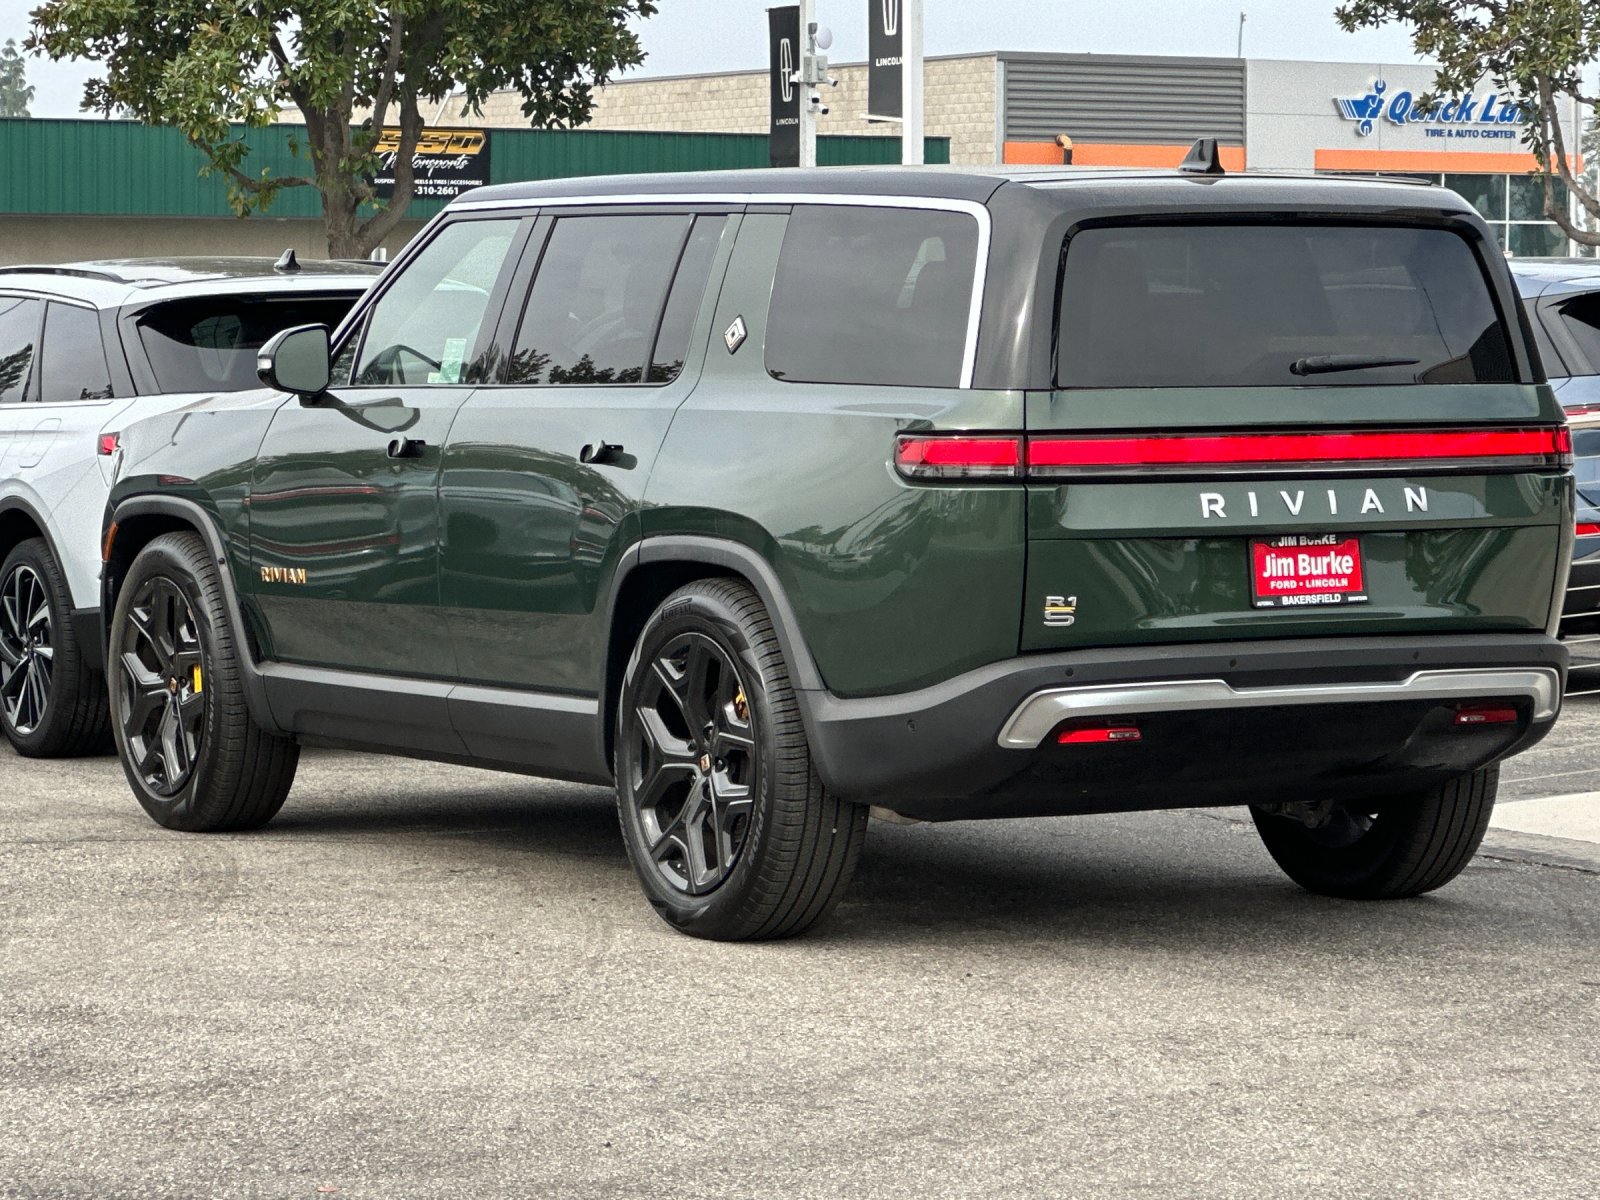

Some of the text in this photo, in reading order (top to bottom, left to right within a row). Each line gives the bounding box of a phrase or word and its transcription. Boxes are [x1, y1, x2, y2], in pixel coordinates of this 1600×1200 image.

[876, 57, 903, 66] LINCOLN
[775, 118, 799, 126] LINCOLN
[1425, 129, 1516, 139] TIRE & AUTO CENTER
[378, 150, 473, 178] Mtorsports
[1199, 487, 1428, 519] RIVIAN
[1278, 536, 1297, 547] JIM
[1263, 551, 1354, 578] Jim Burke
[261, 566, 306, 584] RIVIAN
[1270, 578, 1349, 590] FORD LINCOLN
[1282, 593, 1342, 606] BAKERSFIELD
[661, 597, 693, 620] PIRELLI
